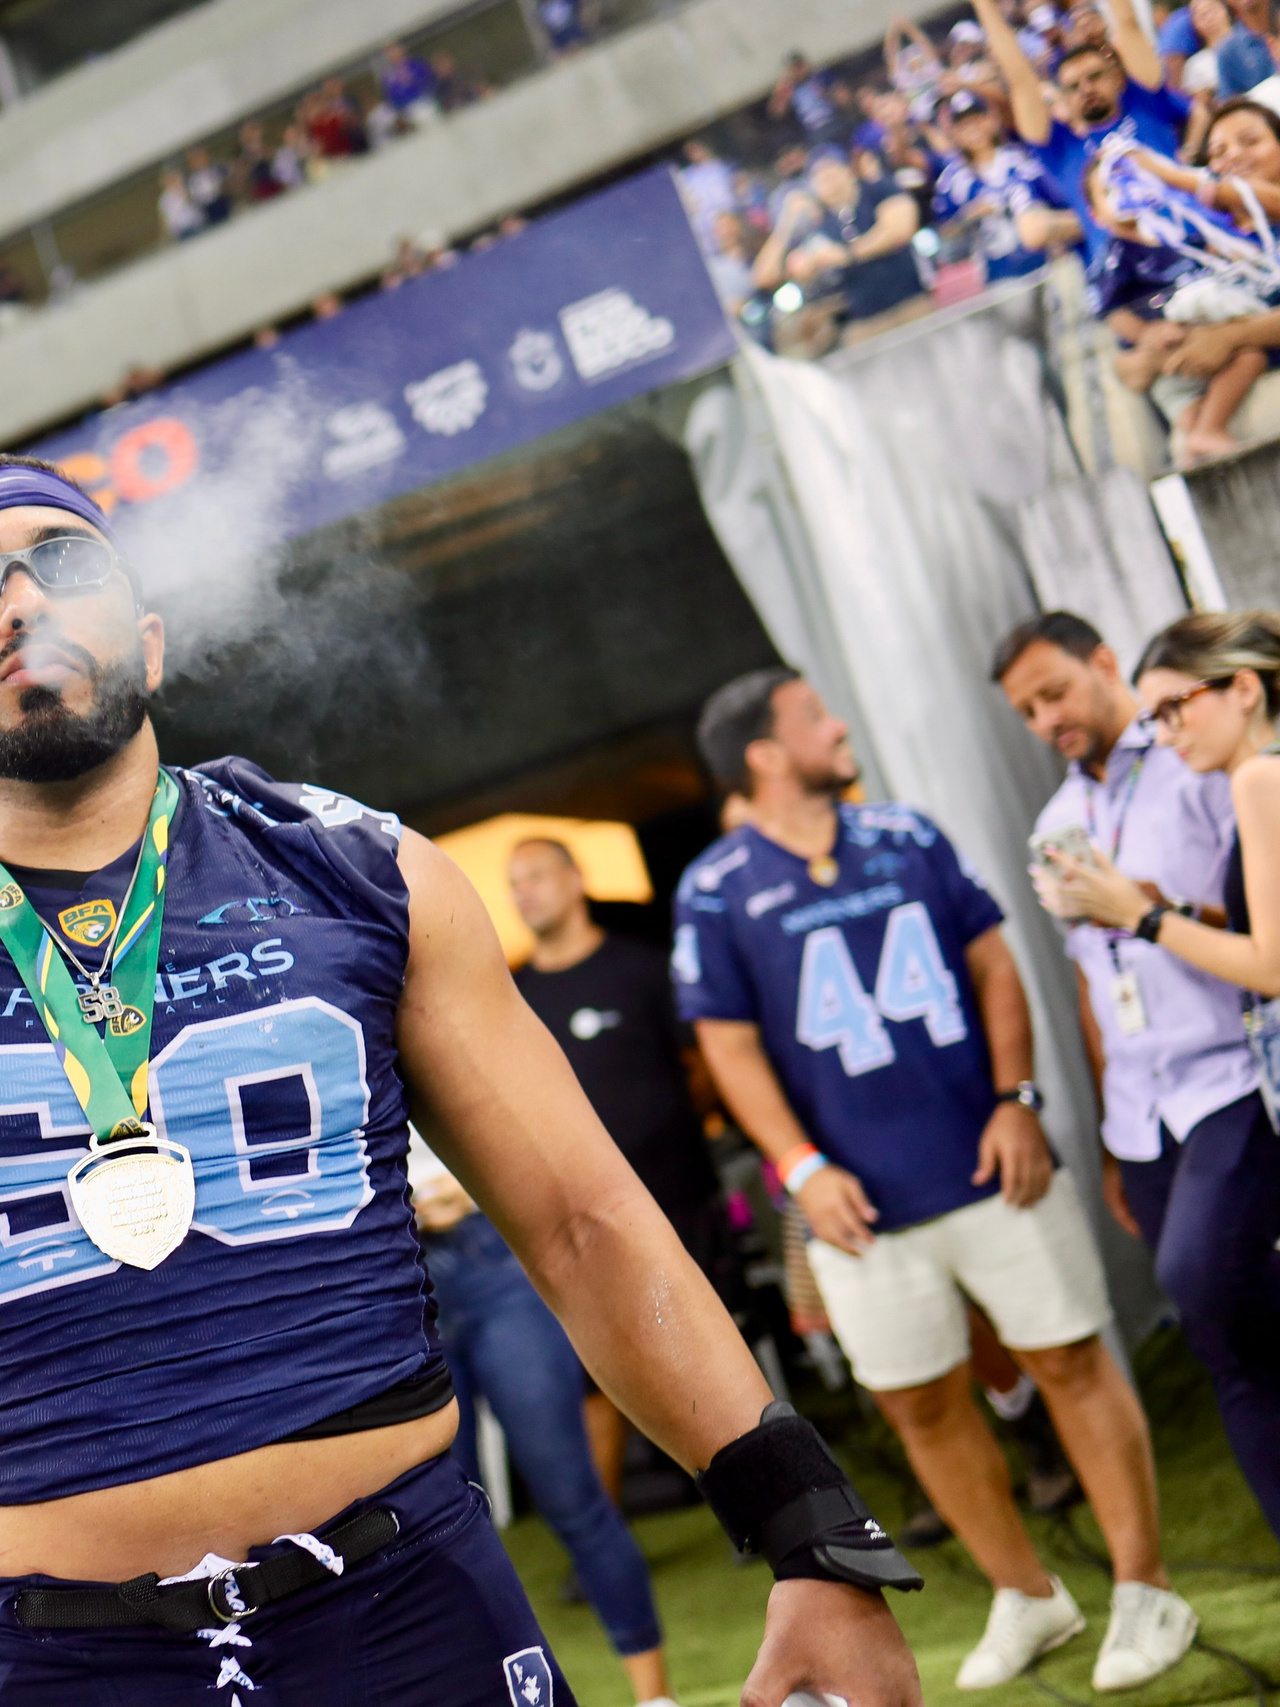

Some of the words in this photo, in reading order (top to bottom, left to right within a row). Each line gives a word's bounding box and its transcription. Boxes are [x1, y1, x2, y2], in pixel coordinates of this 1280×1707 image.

[63, 904, 110, 924] BFA
[78, 987, 125, 1024] 58
[796, 901, 968, 1078] 44
